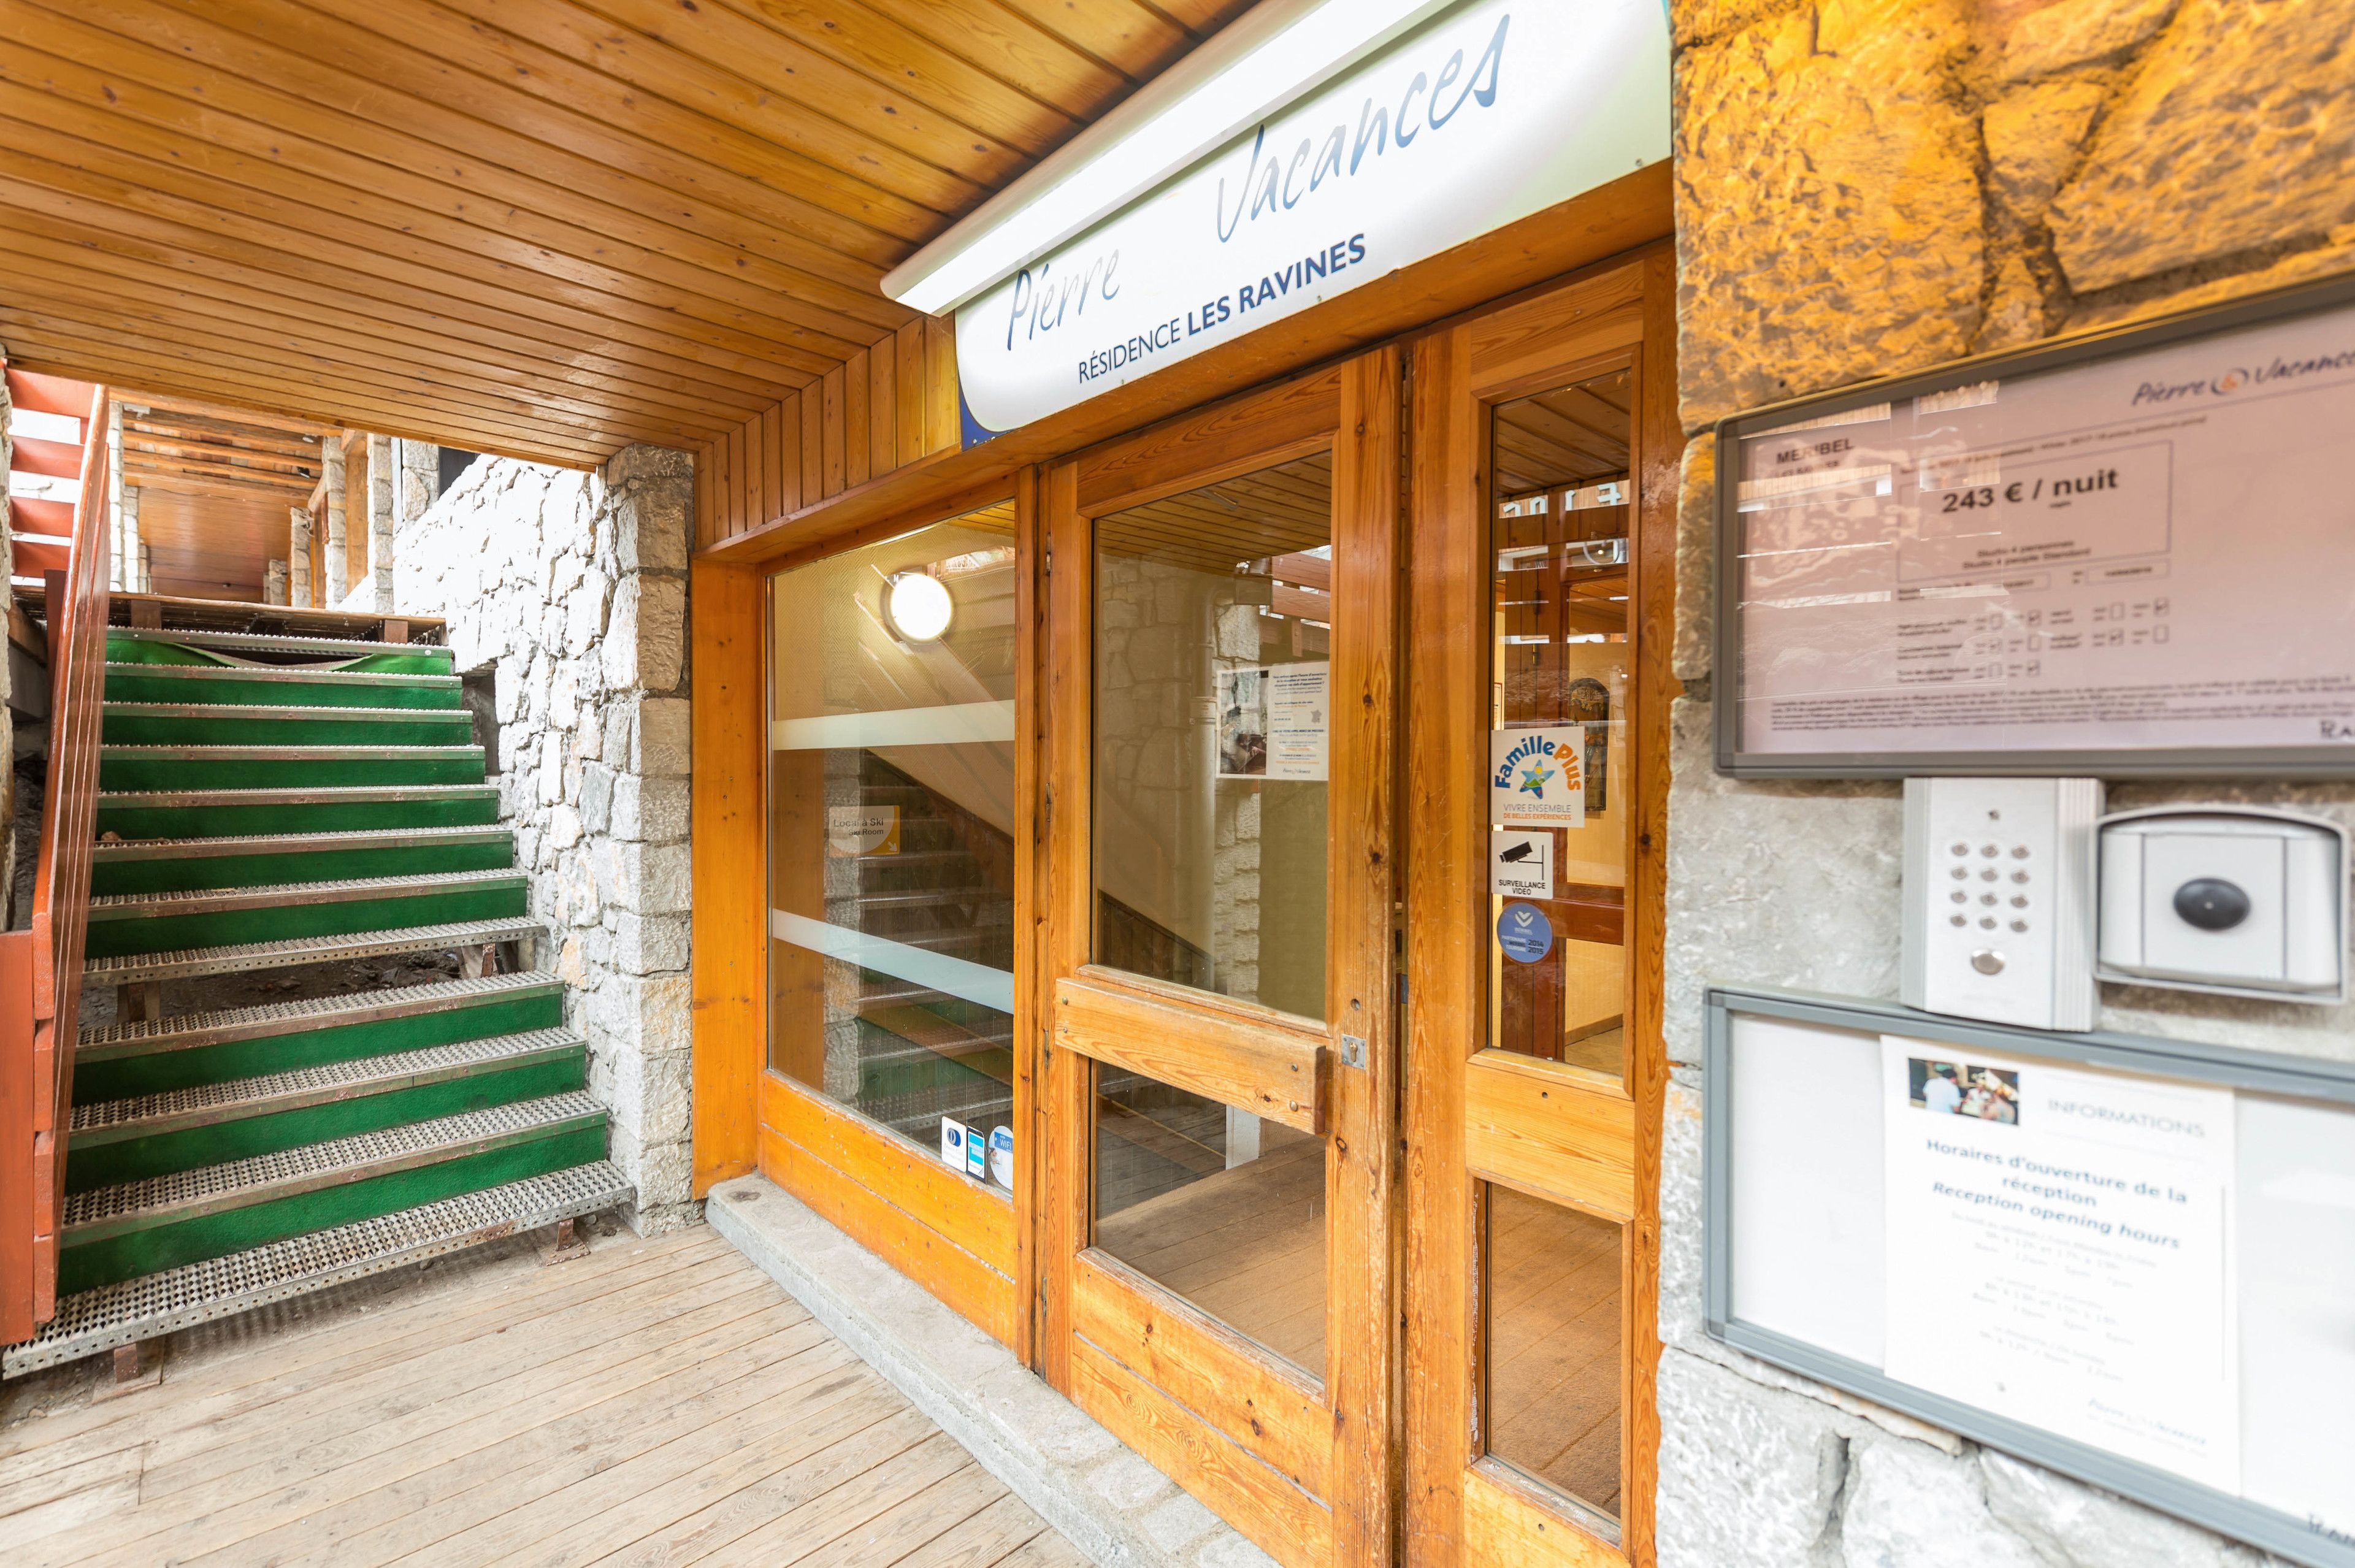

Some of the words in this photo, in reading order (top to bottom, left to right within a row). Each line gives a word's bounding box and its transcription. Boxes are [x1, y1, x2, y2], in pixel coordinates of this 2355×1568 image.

[1007, 249, 1119, 351] Pierre
[1217, 13, 1510, 243] Vacances
[1079, 318, 1180, 383] RÉSIDENCE
[1187, 296, 1230, 336] LES
[1239, 234, 1366, 313] RAVINES
[2132, 381, 2205, 407] Pierre
[1942, 488, 1994, 513] 243
[2004, 482, 2023, 503] €
[2032, 479, 2043, 500] /
[2053, 468, 2120, 497] nuit
[870, 817, 884, 826] Ski
[1528, 805, 1571, 813] ENSEMBLE
[1498, 879, 1546, 889] SURVEILLANCE
[1528, 939, 1544, 948] 2014
[2047, 1100, 2205, 1138] INFORMATIONS
[1926, 1139, 2003, 1165] Horaires
[2009, 1156, 2127, 1191] d'ouverture
[2134, 1182, 2161, 1198] de
[2168, 1188, 2188, 1204] la
[2002, 1176, 2097, 1207] réception
[1932, 1181, 2024, 1212] Reception
[2030, 1206, 2112, 1235] opening
[2120, 1225, 2180, 1249] hours
